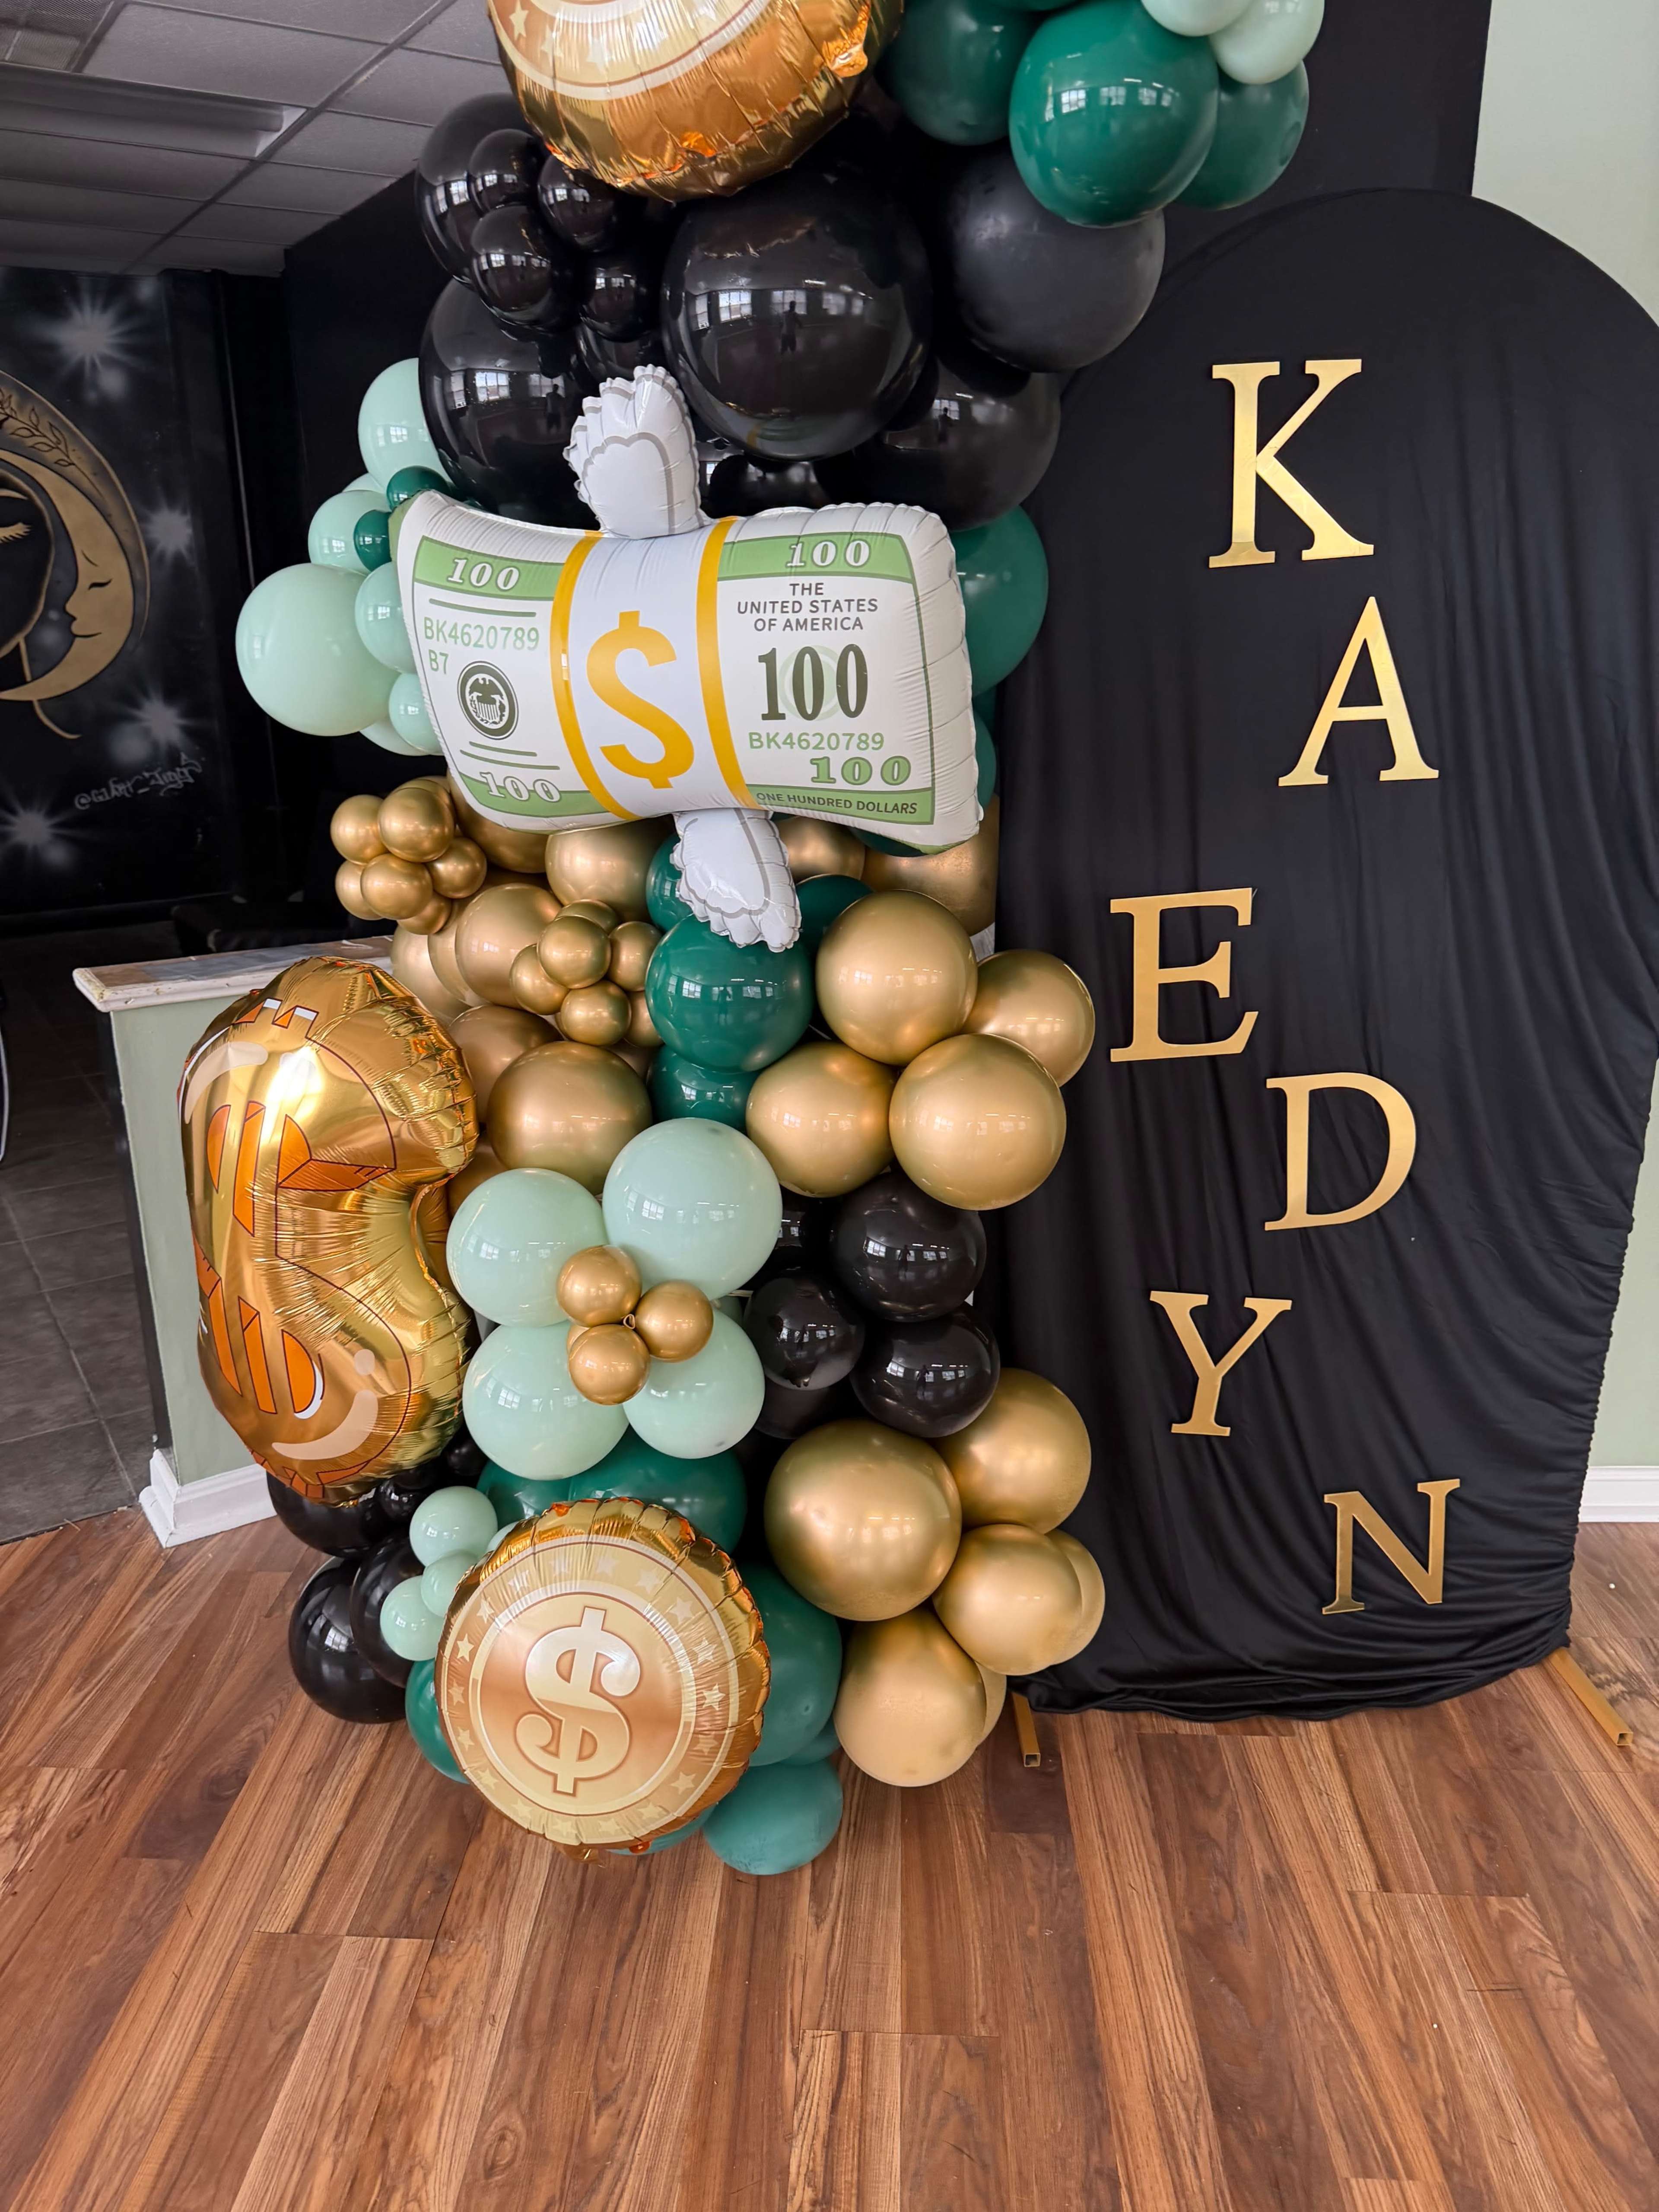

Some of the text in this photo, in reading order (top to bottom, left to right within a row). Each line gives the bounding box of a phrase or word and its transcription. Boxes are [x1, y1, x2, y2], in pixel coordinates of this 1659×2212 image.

[785, 539, 871, 568] 100
[446, 557, 520, 591] 100
[789, 582, 824, 596] THE
[737, 598, 878, 614] UNITED STATES
[424, 617, 539, 650] BK4620789
[753, 617, 864, 632] OF AMERICA
[429, 649, 449, 675] B7
[757, 644, 868, 721] 100
[749, 732, 885, 751] BK4620789
[810, 755, 912, 786] 100
[480, 770, 561, 802] 100
[756, 793, 917, 815] ONE HUNDRED DOLLARS
